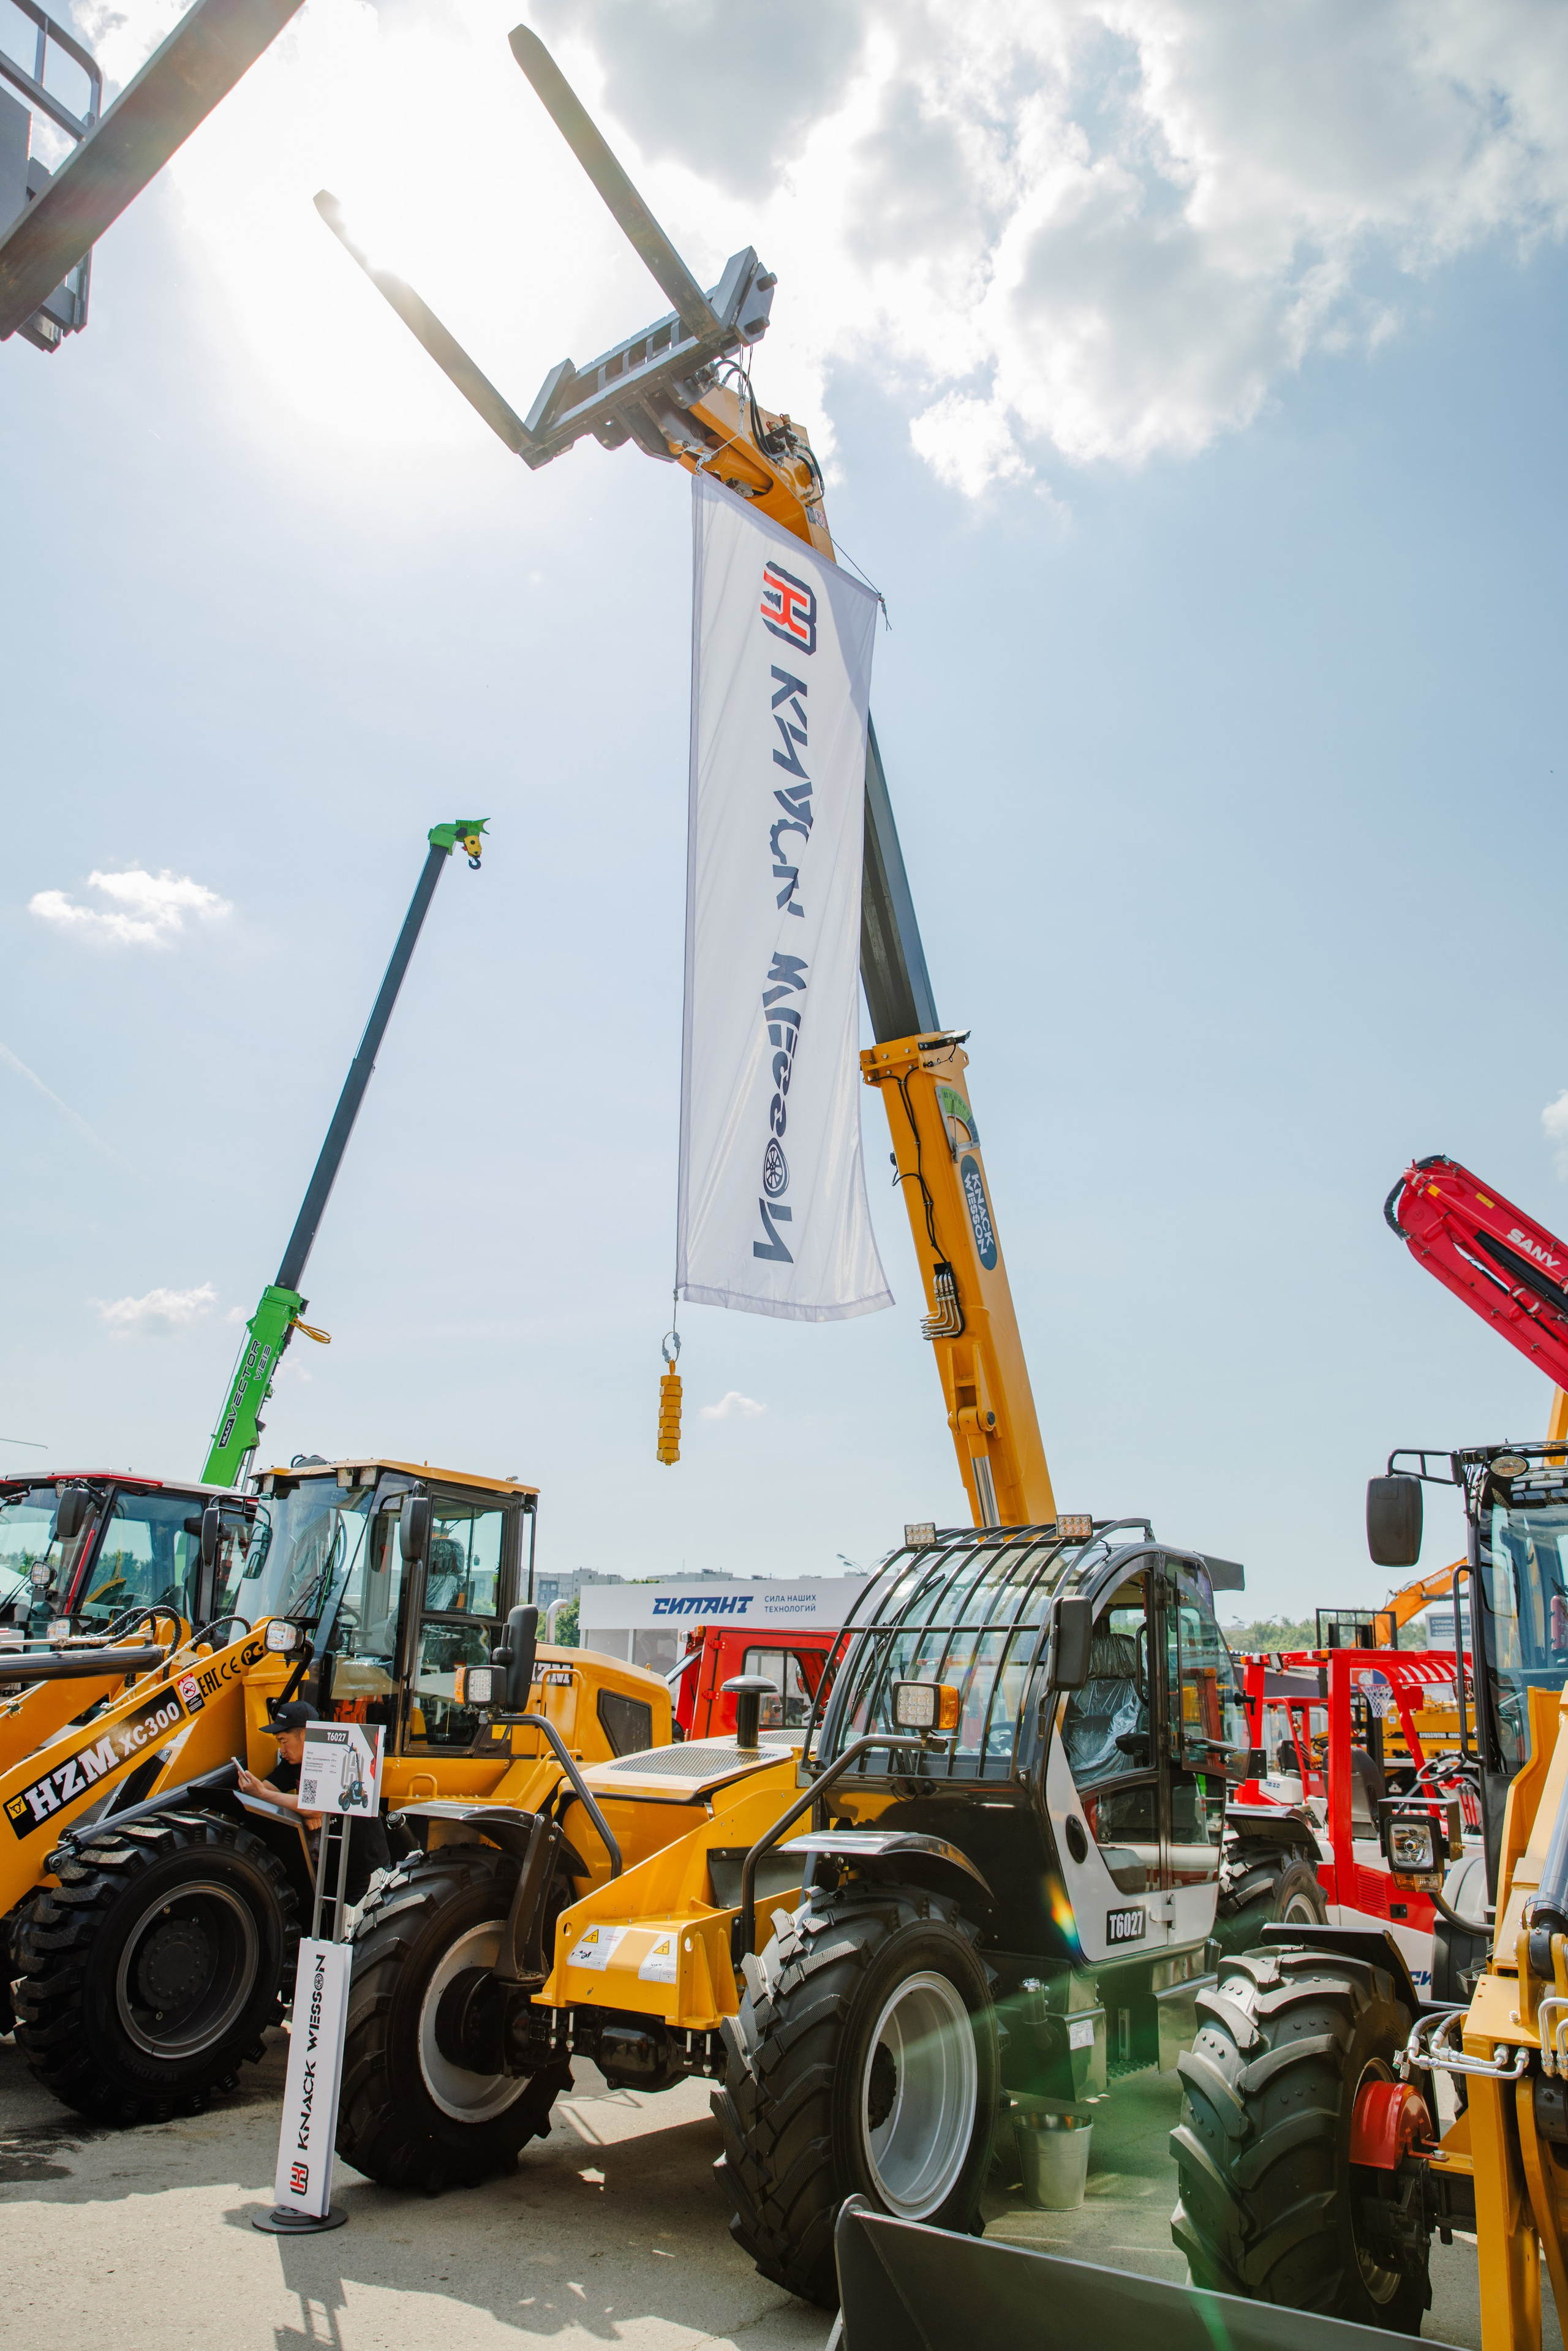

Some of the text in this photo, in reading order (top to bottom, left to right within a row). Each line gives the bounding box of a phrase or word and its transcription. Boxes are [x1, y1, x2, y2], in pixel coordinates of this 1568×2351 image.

[964, 1172, 987, 1255] WESSON
[971, 1174, 994, 1247] KNACK
[1506, 1228, 1561, 1268] SANY
[221, 1340, 261, 1445] MULTI VECTOR
[1423, 1568, 1451, 1588] BORUS
[652, 1596, 754, 1615] СИЛАНТ
[764, 1604, 816, 1613] ТЕХНОЛОГИЙ
[221, 1656, 241, 1680] CE
[327, 1732, 347, 1742] T6027
[24, 1736, 119, 1822] HZM
[1109, 1911, 1144, 1939] T6027
[297, 1953, 326, 2151] KNACK WESSON
